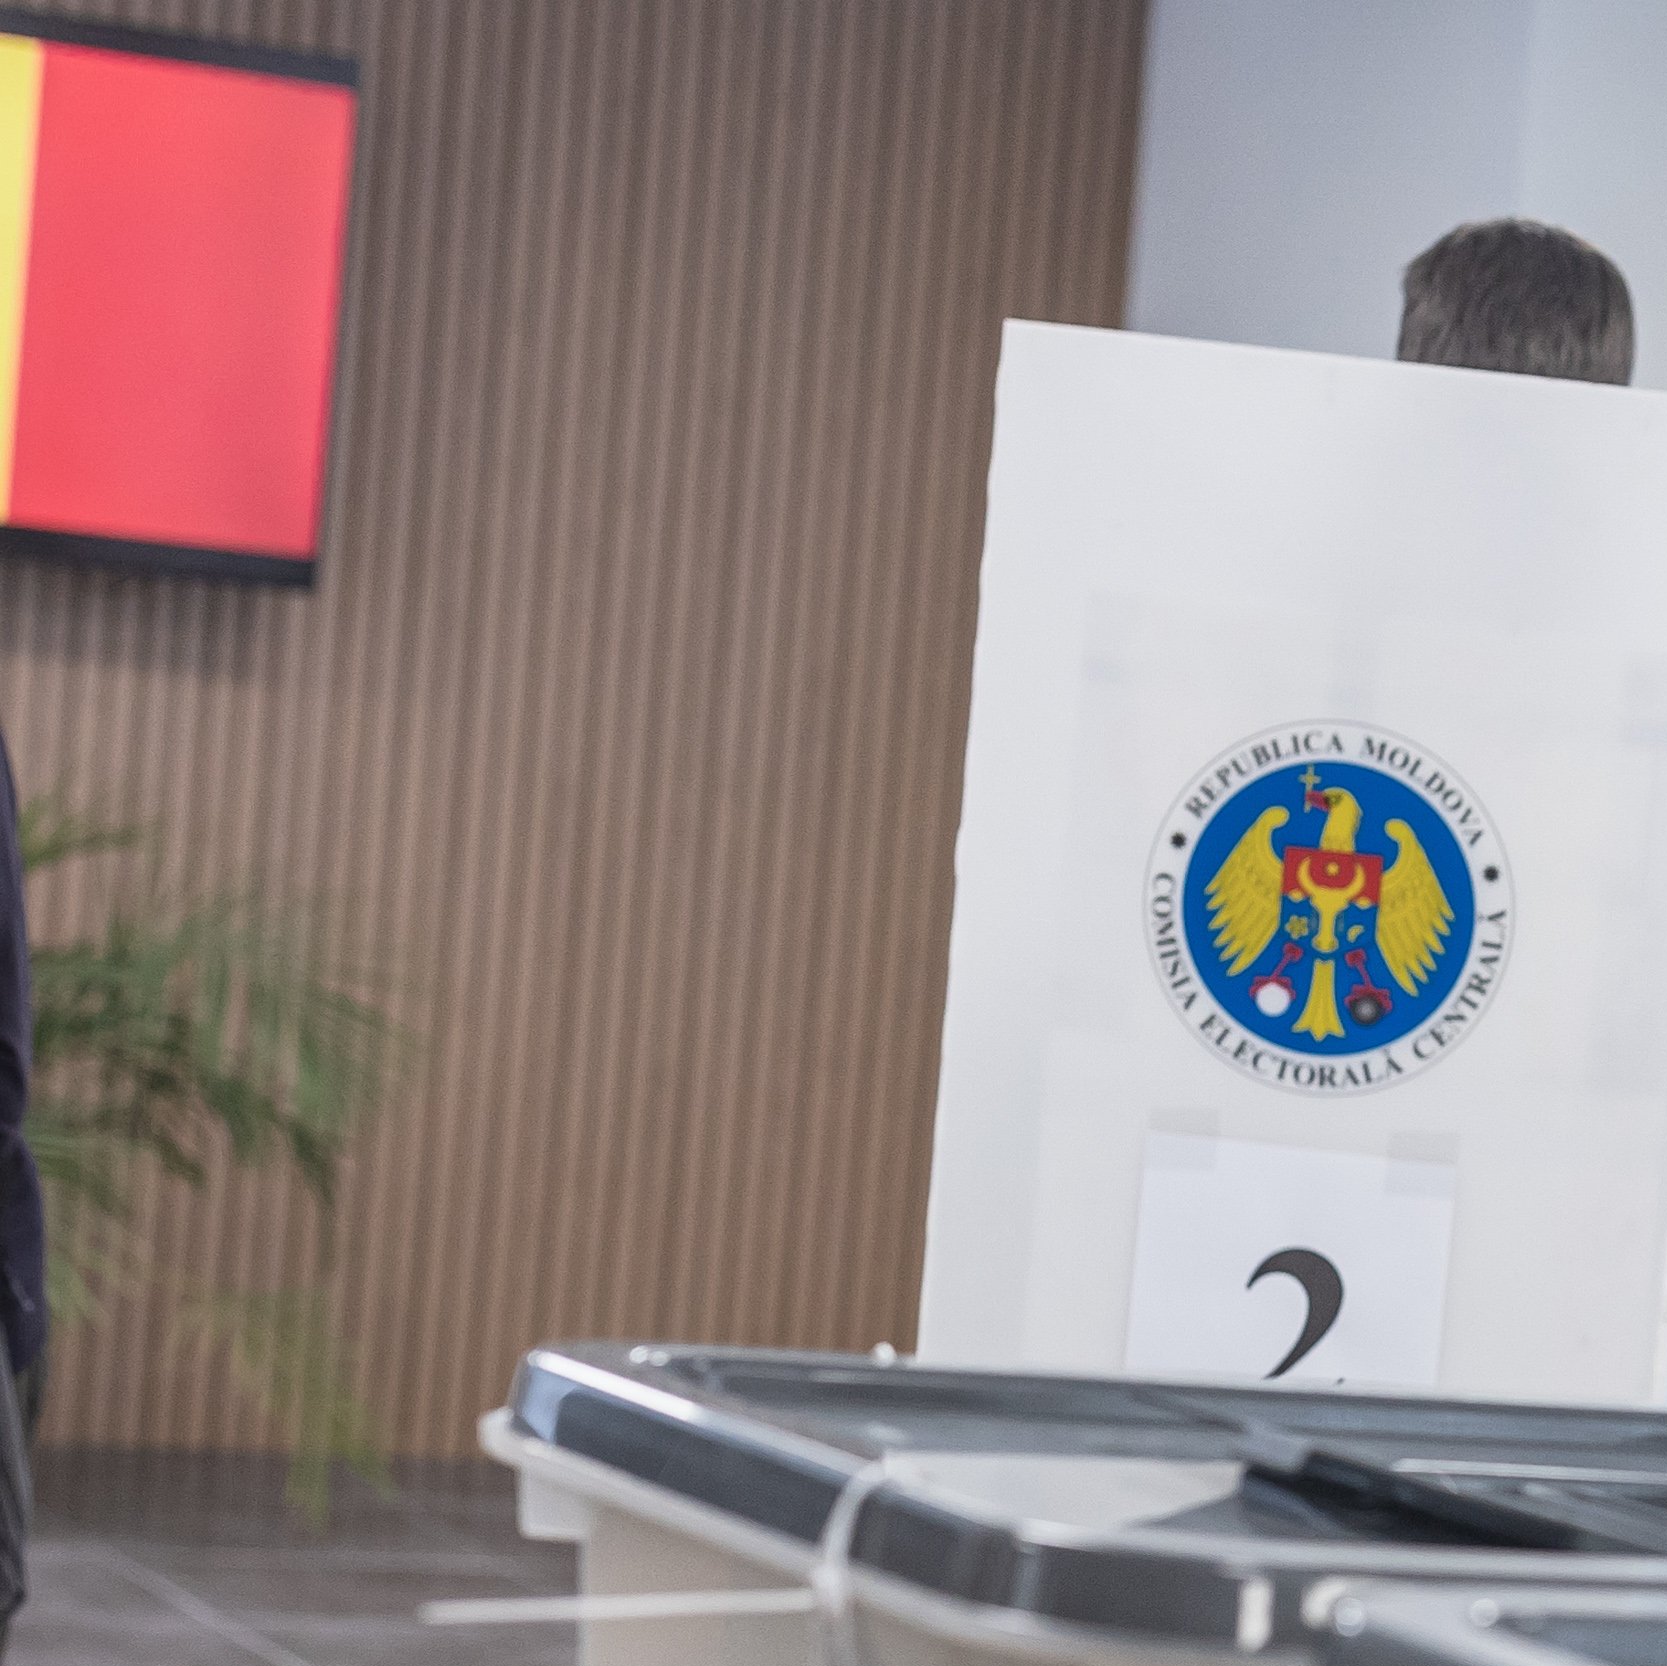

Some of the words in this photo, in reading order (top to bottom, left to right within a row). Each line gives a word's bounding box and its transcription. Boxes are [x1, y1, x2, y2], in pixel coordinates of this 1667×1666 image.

[1184, 730, 1345, 819] REPUBLICA
[1362, 736, 1485, 847] MOLDOVA
[1152, 872, 1198, 1011] COMISIA
